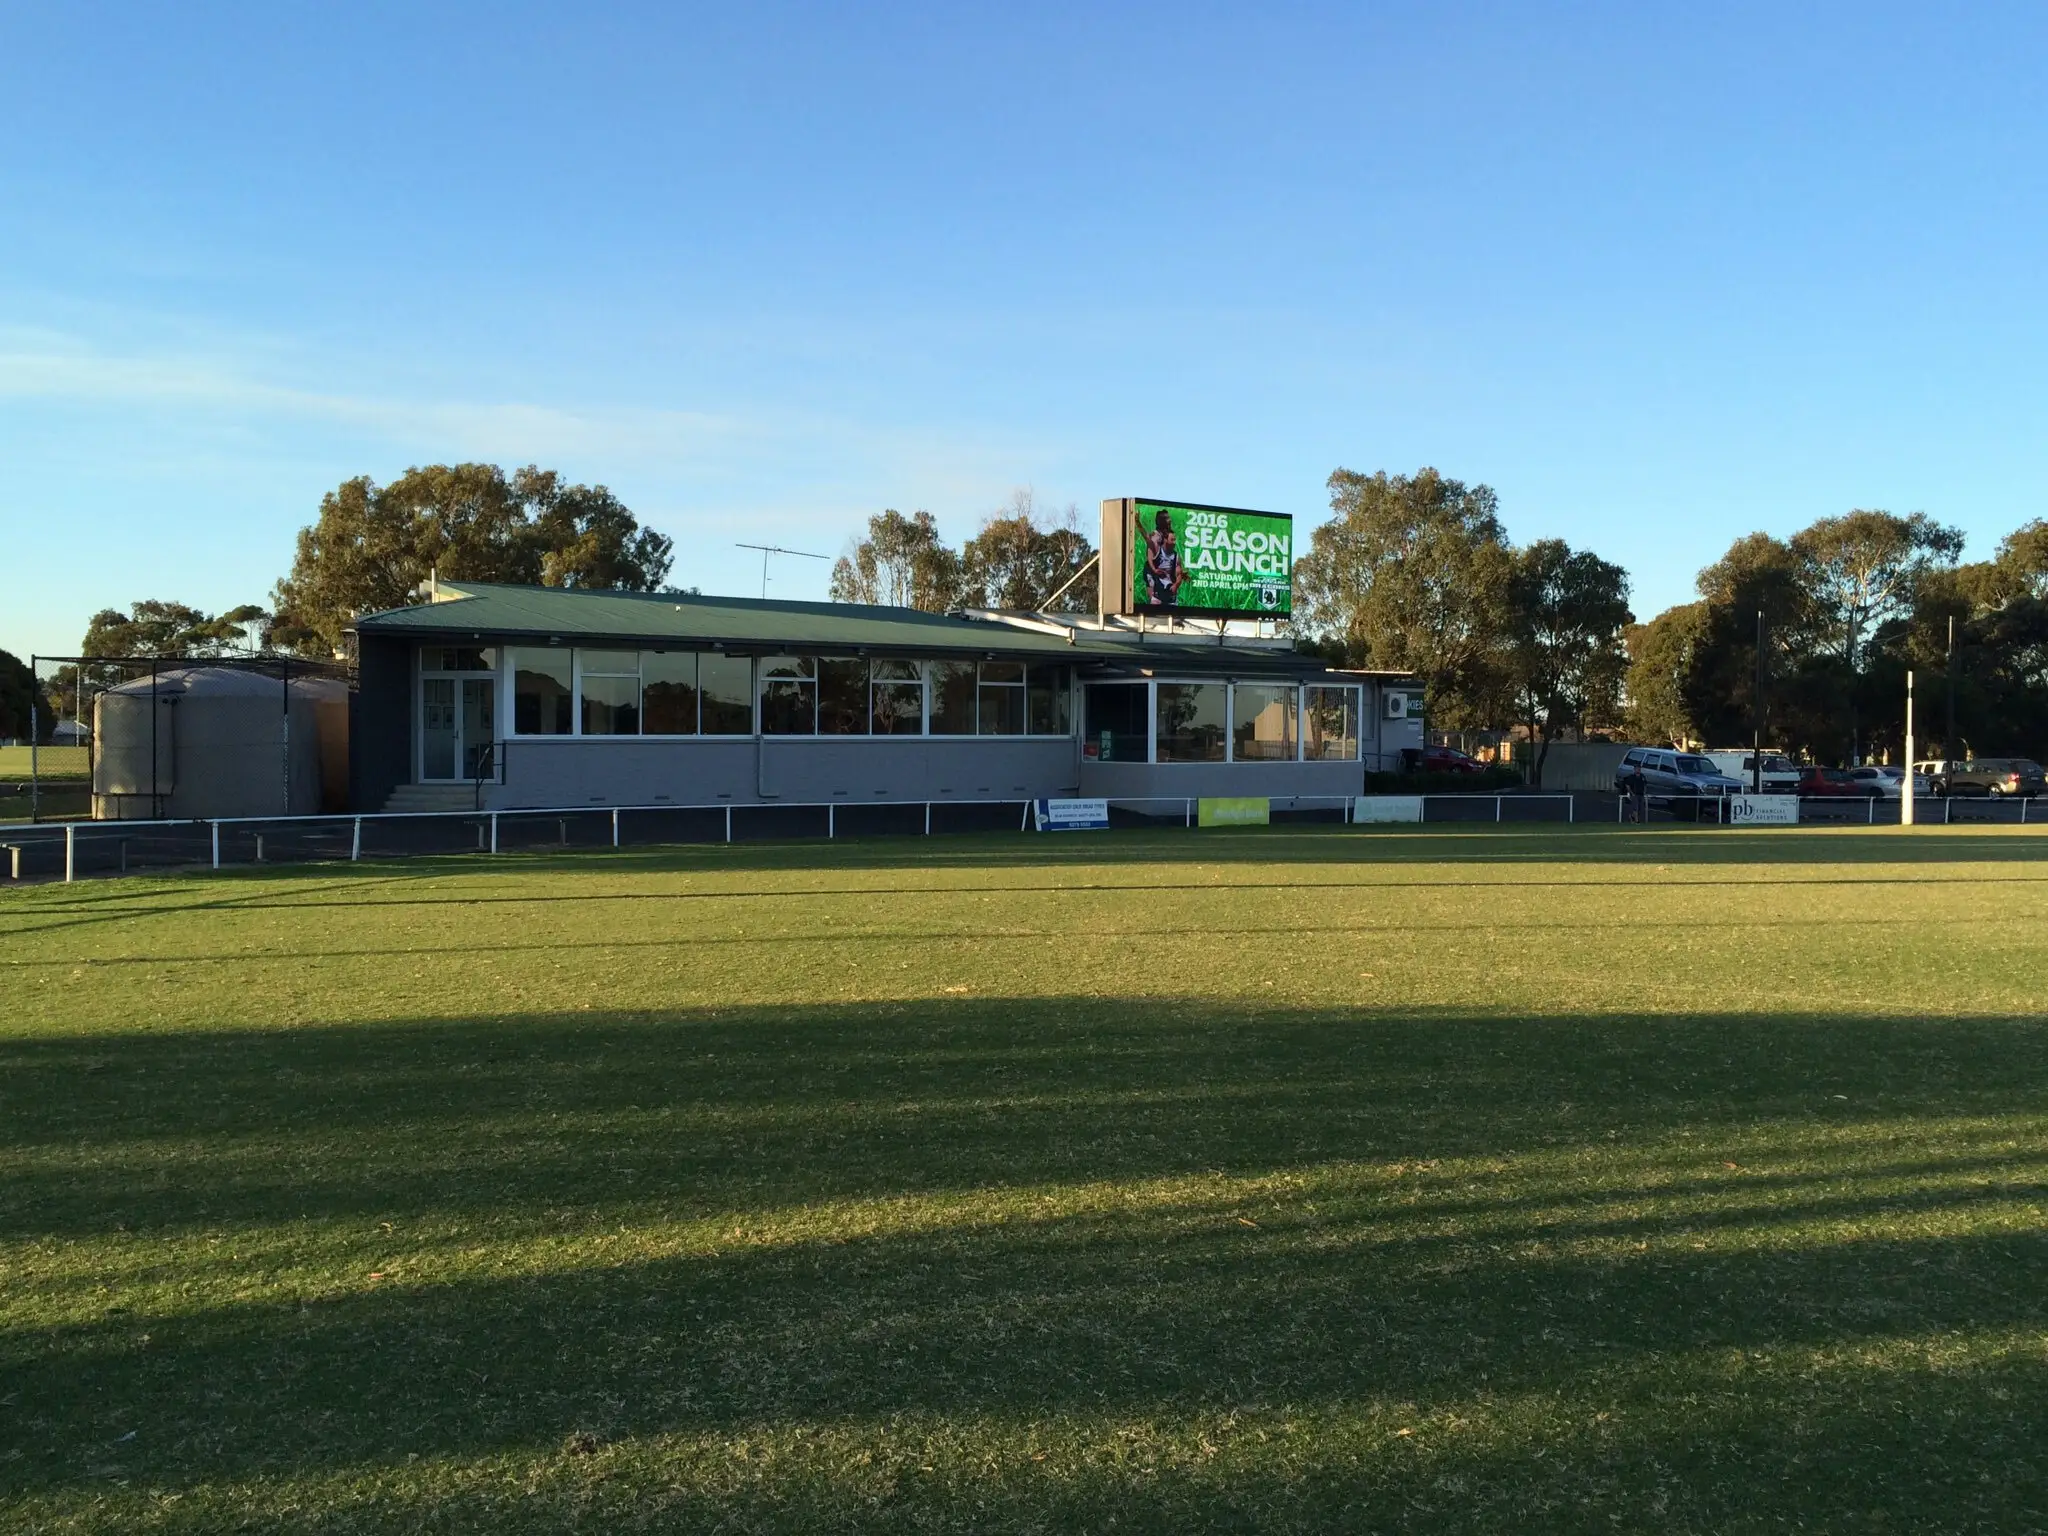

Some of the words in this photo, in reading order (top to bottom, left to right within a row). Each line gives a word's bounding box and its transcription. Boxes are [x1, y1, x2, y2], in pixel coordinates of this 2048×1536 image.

[1186, 511, 1228, 528] 2016
[1184, 526, 1289, 555] SEASON
[1184, 548, 1289, 576] LAUNCH
[1192, 580, 1209, 588] 2ND
[1209, 581, 1231, 590] APRIL
[1232, 582, 1249, 591] 6PM
[1198, 572, 1243, 582] SATURDAY
[1407, 699, 1424, 710] KIES
[1733, 799, 1753, 820] pb
